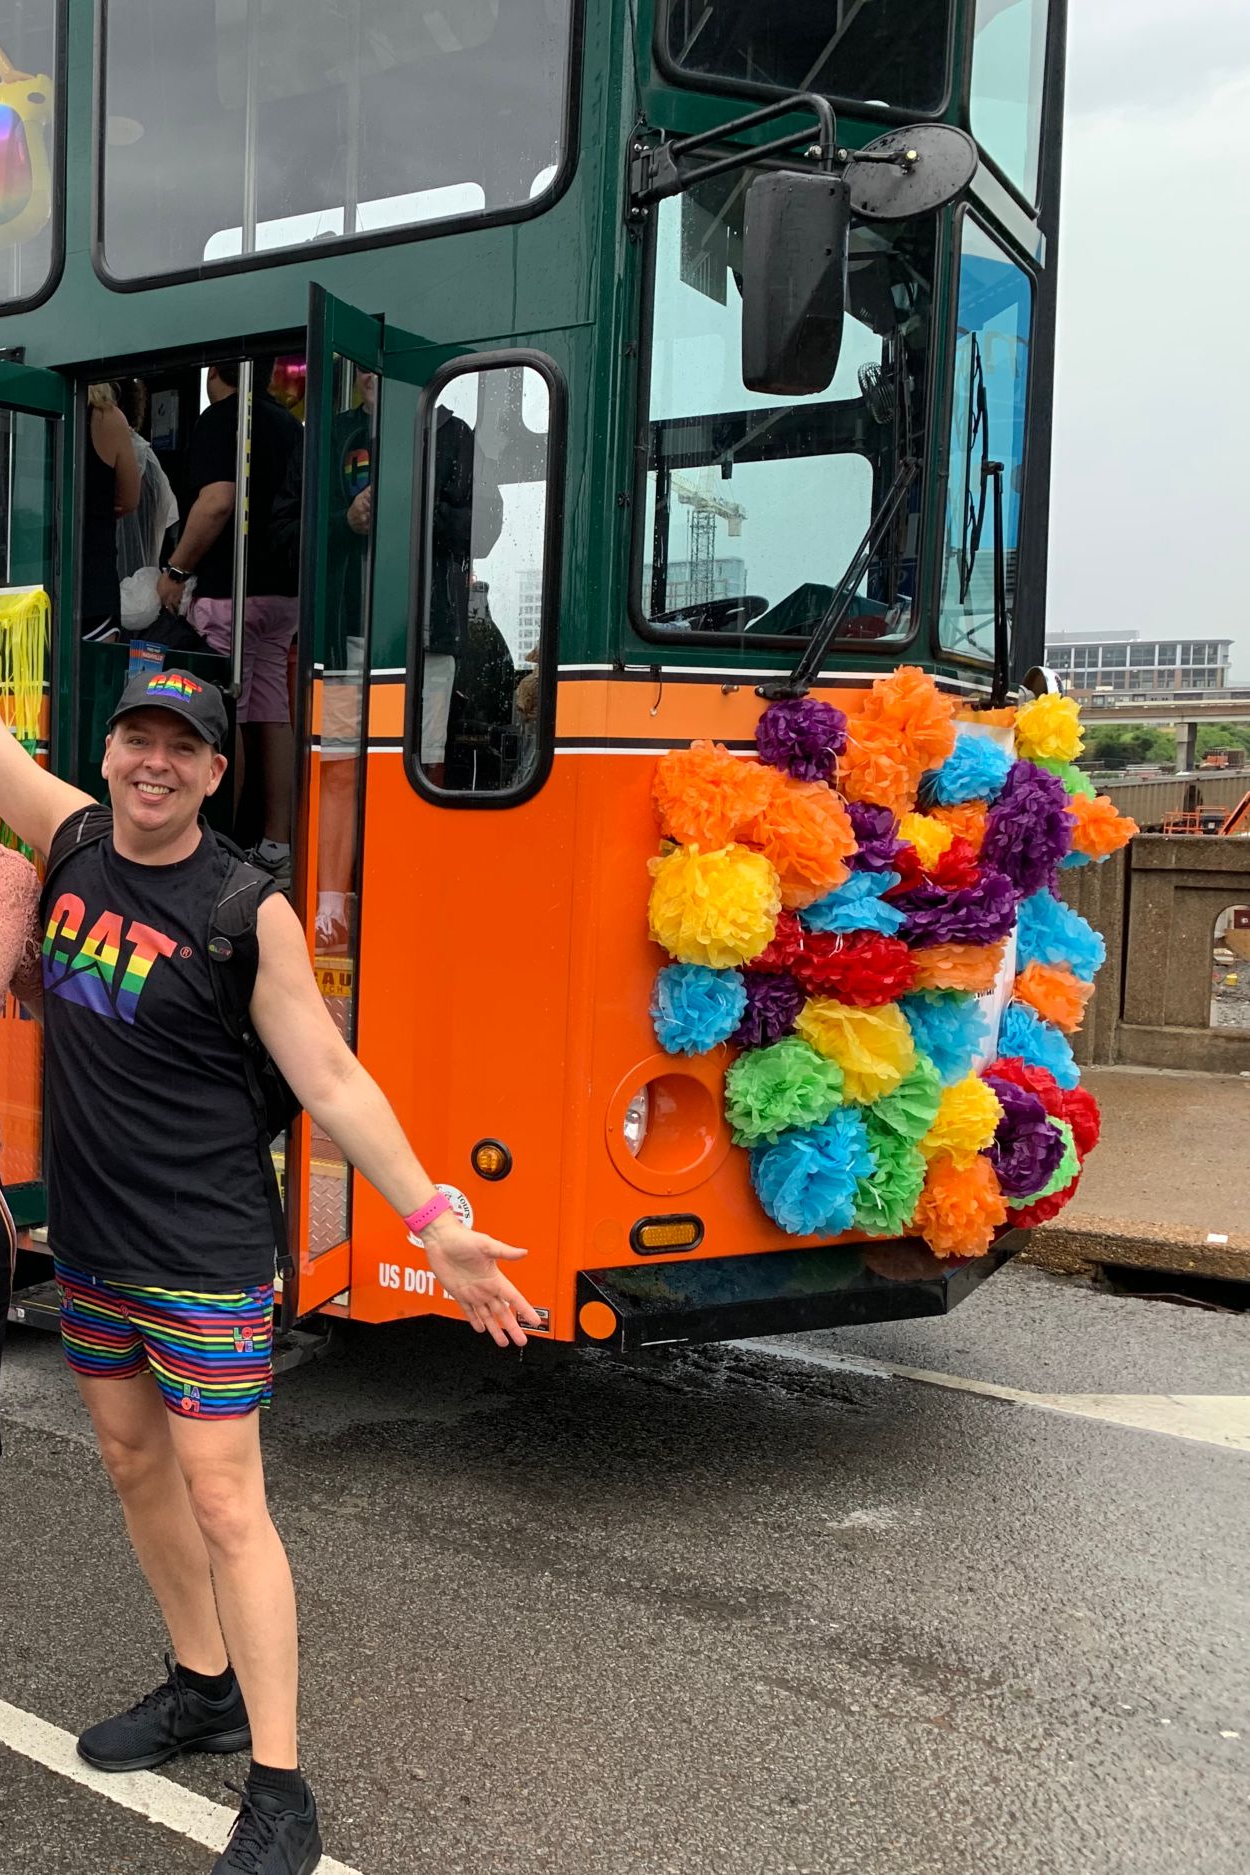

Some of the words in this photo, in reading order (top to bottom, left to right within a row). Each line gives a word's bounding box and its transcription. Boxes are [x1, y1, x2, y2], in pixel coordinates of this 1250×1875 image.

[456, 1193, 471, 1219] Tours
[379, 1262, 400, 1289] US
[404, 1266, 436, 1296] DOT
